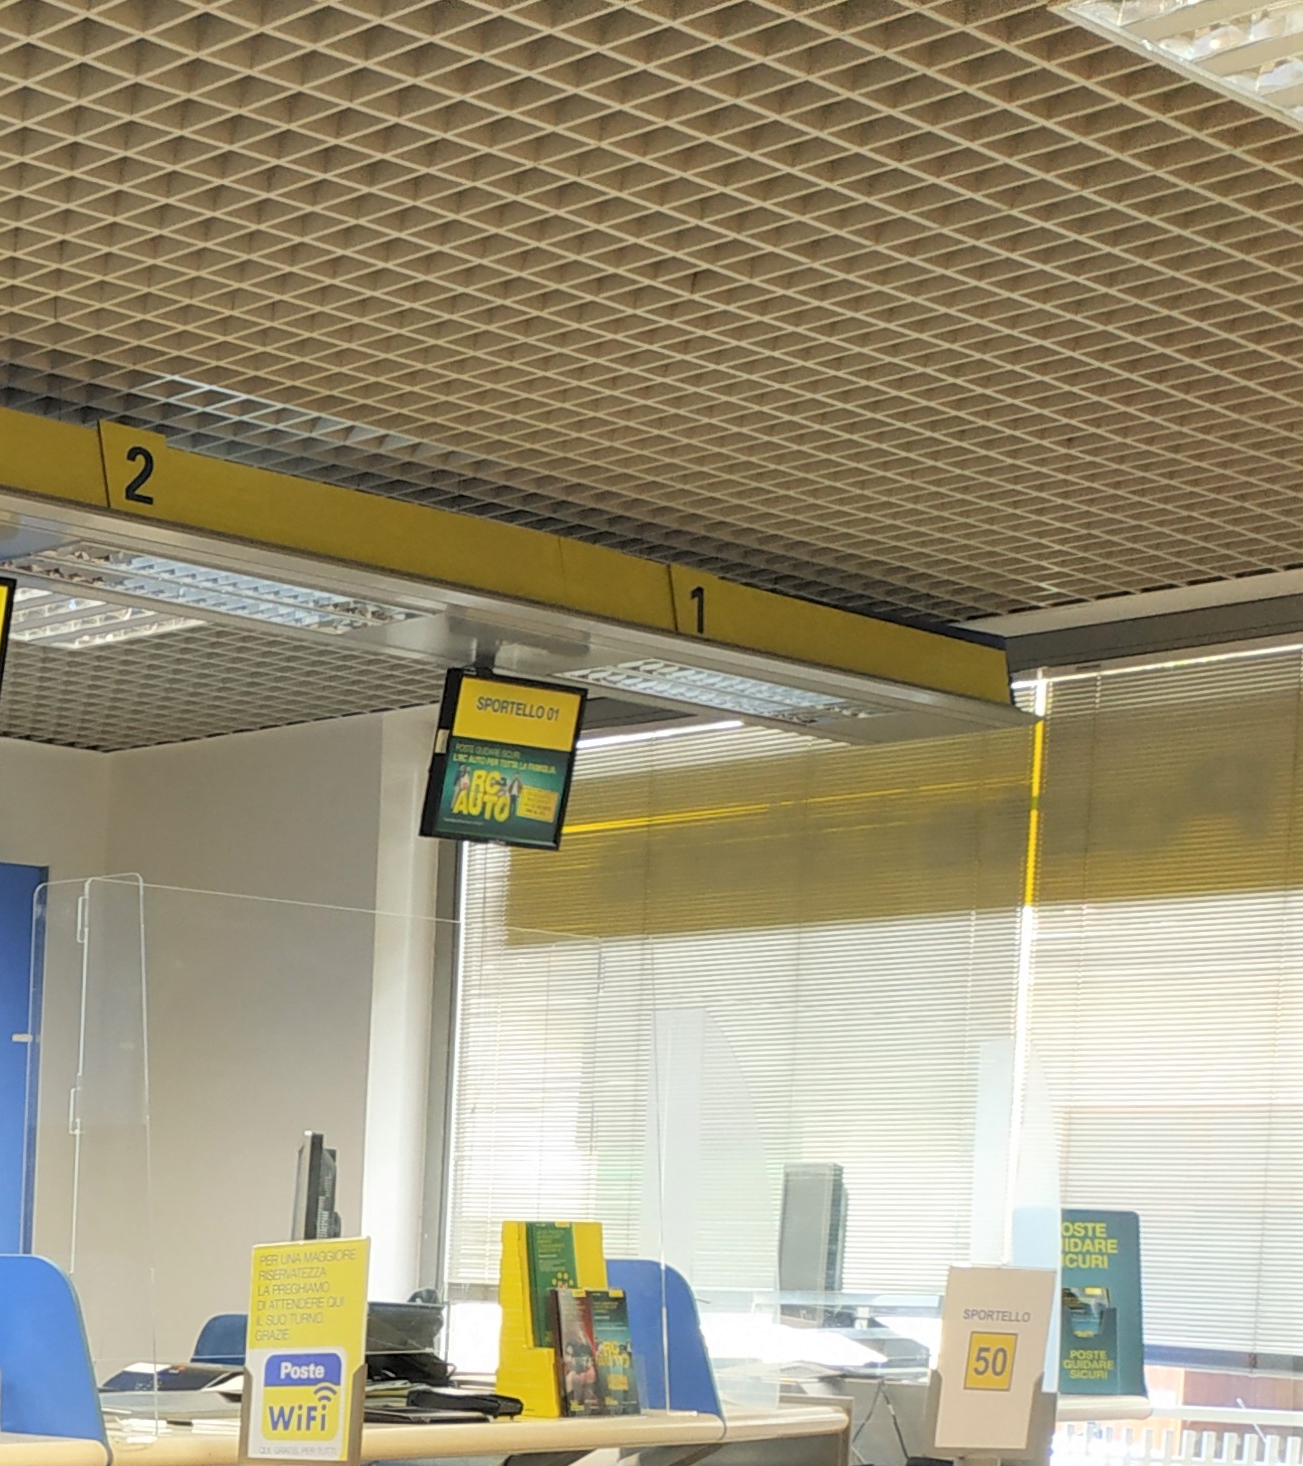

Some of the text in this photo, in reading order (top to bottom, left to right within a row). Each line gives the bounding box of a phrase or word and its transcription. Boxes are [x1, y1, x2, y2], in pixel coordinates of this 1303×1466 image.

[125, 446, 154, 506] 2
[690, 586, 704, 634] 1
[476, 696, 560, 721] SPORTELLO 01
[471, 769, 502, 794] RC
[452, 789, 511, 823] AUTO
[1061, 1222, 1107, 1238] OSTE
[1061, 1238, 1119, 1254] IDARE
[259, 1248, 356, 1267] PER UNA MAGGIORE
[1061, 1254, 1108, 1269] ICURI
[258, 1266, 327, 1281] RISERVATEZZA
[257, 1281, 330, 1297] LA PREGHIAMO
[257, 1296, 345, 1311] DI ATTENDERE QUI
[266, 1314, 287, 1326] SUO
[289, 1311, 324, 1325] TURNO
[962, 1308, 1031, 1323] SPORTELLO
[255, 1328, 290, 1341] GRAZIE
[973, 1346, 1008, 1377] 50
[1069, 1350, 1108, 1361] POSTE
[280, 1360, 325, 1379] Poste
[1063, 1360, 1115, 1370] GUIDARE
[1069, 1370, 1108, 1379] SICURI
[268, 1404, 327, 1431] WiFi
